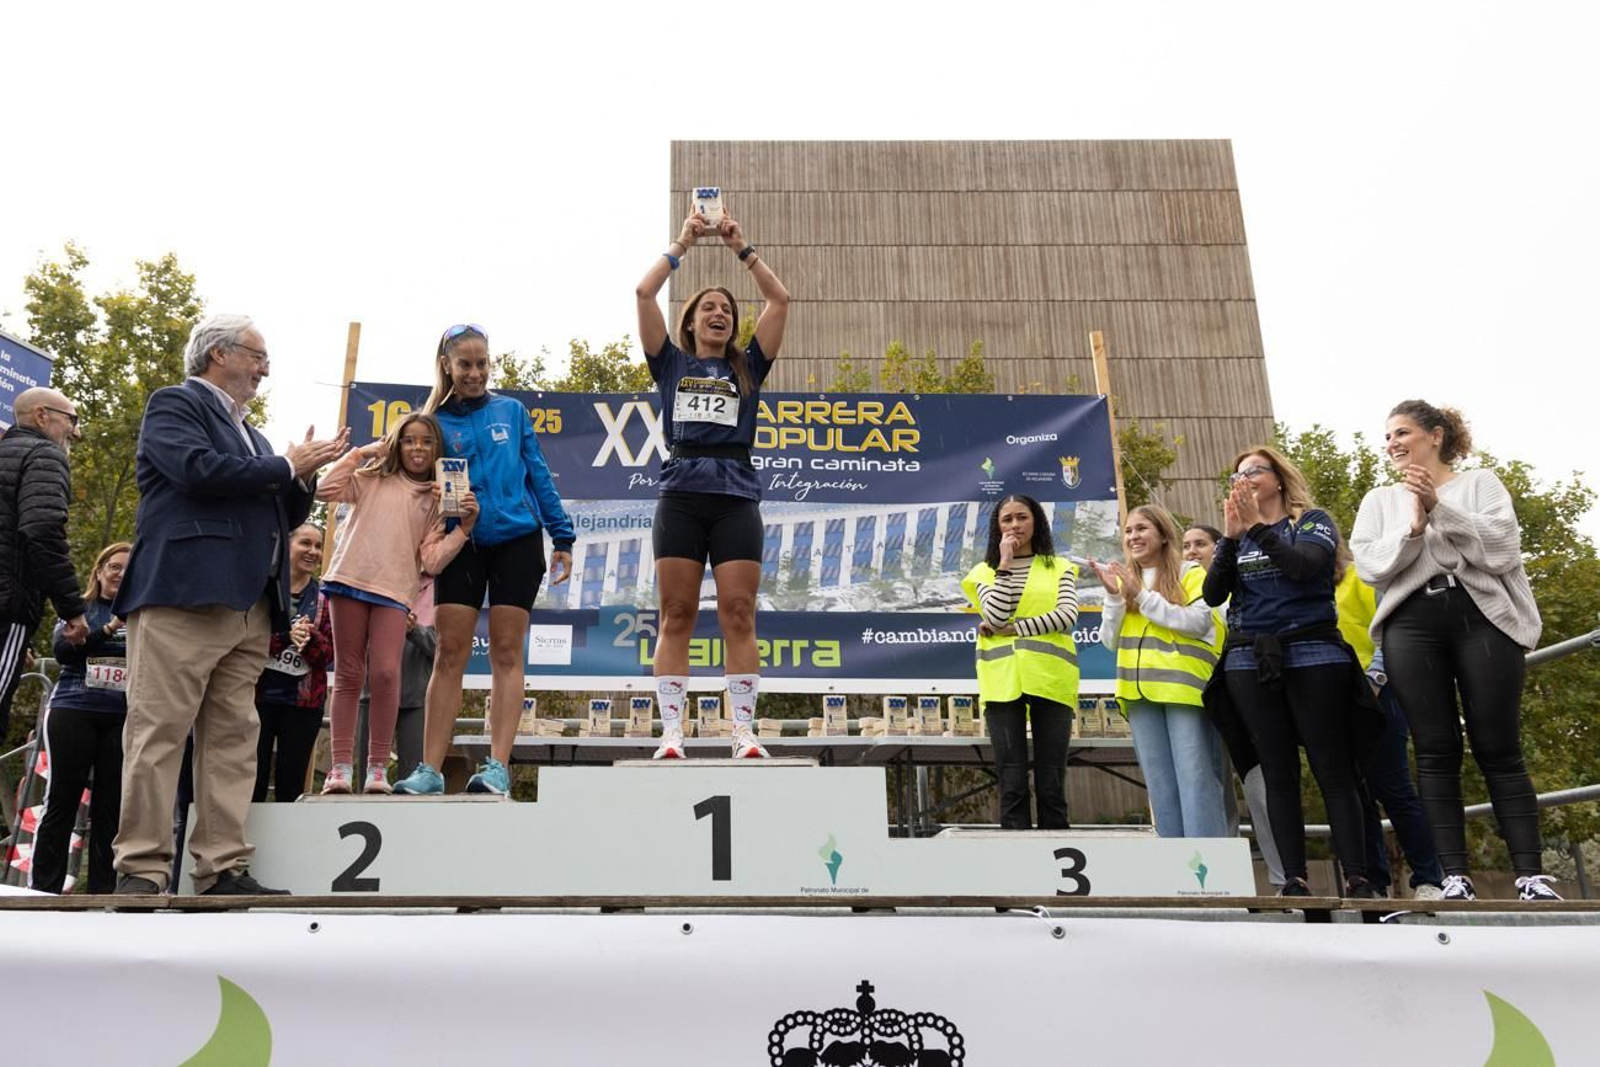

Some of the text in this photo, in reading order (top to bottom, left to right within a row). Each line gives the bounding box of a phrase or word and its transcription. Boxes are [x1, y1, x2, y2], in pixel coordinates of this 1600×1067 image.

[687, 396, 726, 413] 412
[757, 401, 917, 425] ARRERA
[531, 409, 562, 433] 25
[592, 401, 671, 467] XX
[754, 427, 921, 453] OPULAR
[1006, 433, 1058, 445] Organiza
[750, 455, 921, 472] gran caminata
[629, 473, 868, 500] Por Integración
[576, 513, 652, 531] lejandría
[612, 613, 657, 647] 25
[862, 628, 977, 645] #cambiand
[693, 796, 732, 881] 1
[331, 821, 383, 893] 2
[1053, 847, 1091, 896] 3
